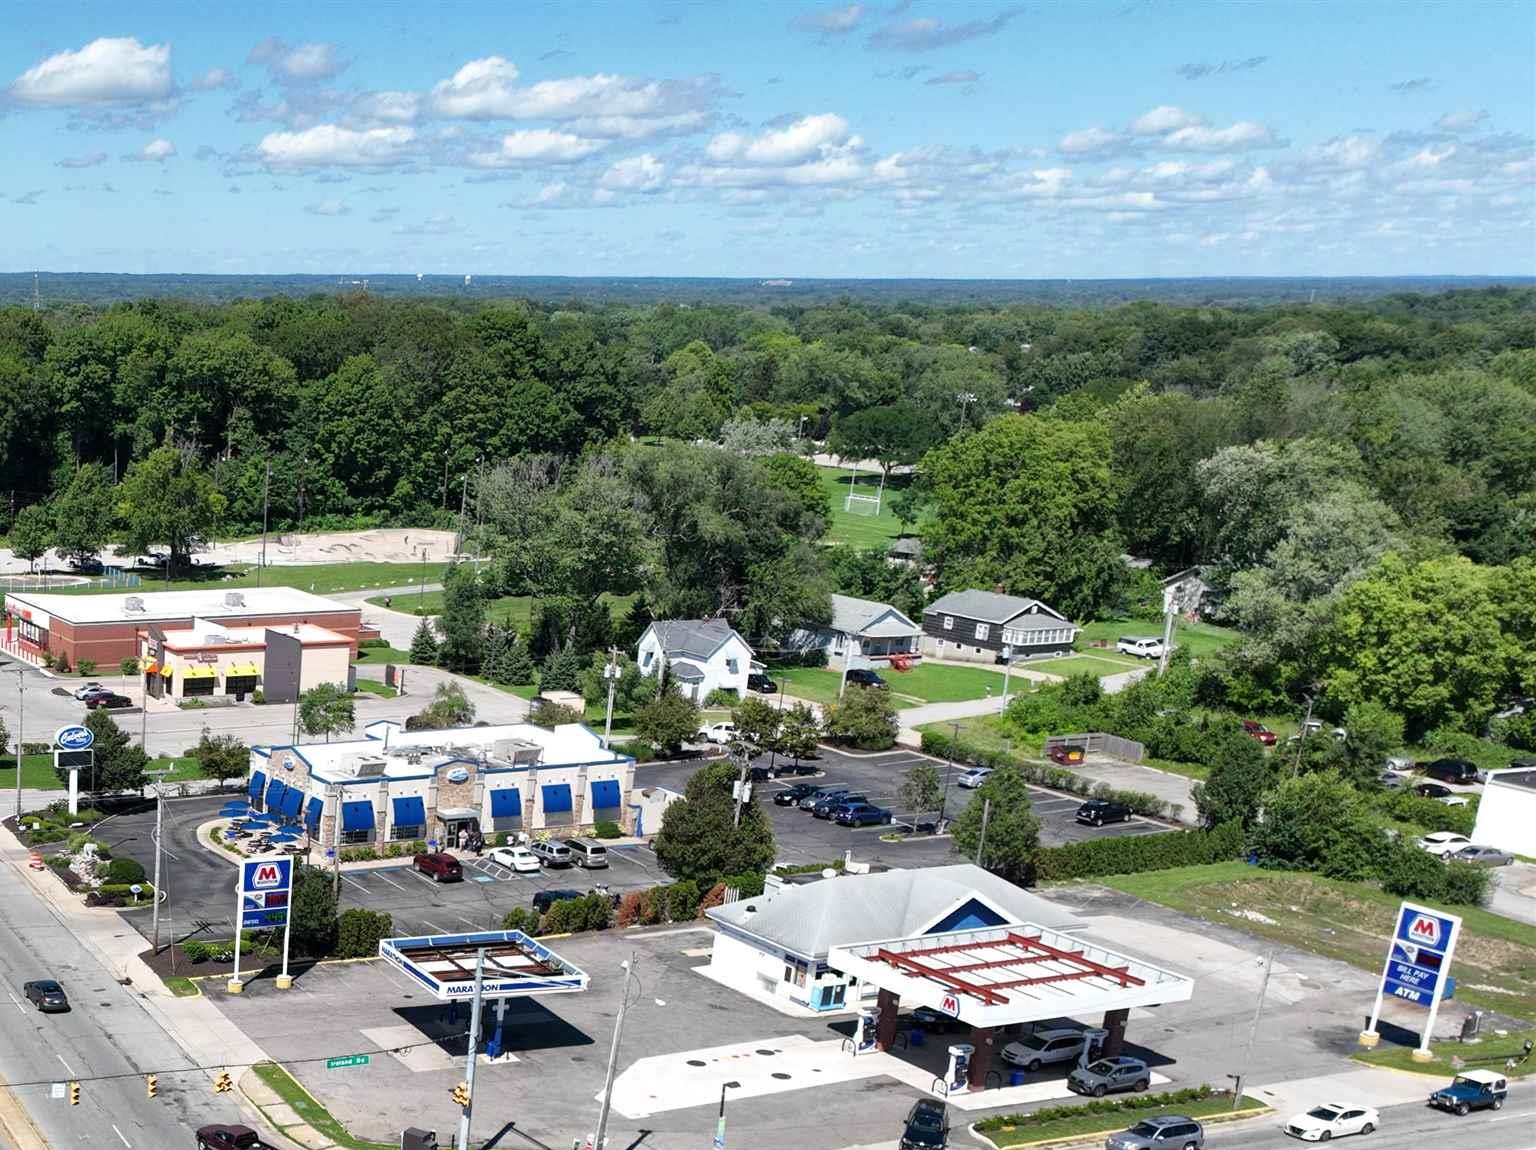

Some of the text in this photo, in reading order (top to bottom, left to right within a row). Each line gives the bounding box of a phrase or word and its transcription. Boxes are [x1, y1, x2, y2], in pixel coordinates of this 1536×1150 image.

[1400, 974, 1420, 985] HERE
[1413, 969, 1430, 980] PAY
[1394, 986, 1421, 1001] ATM
